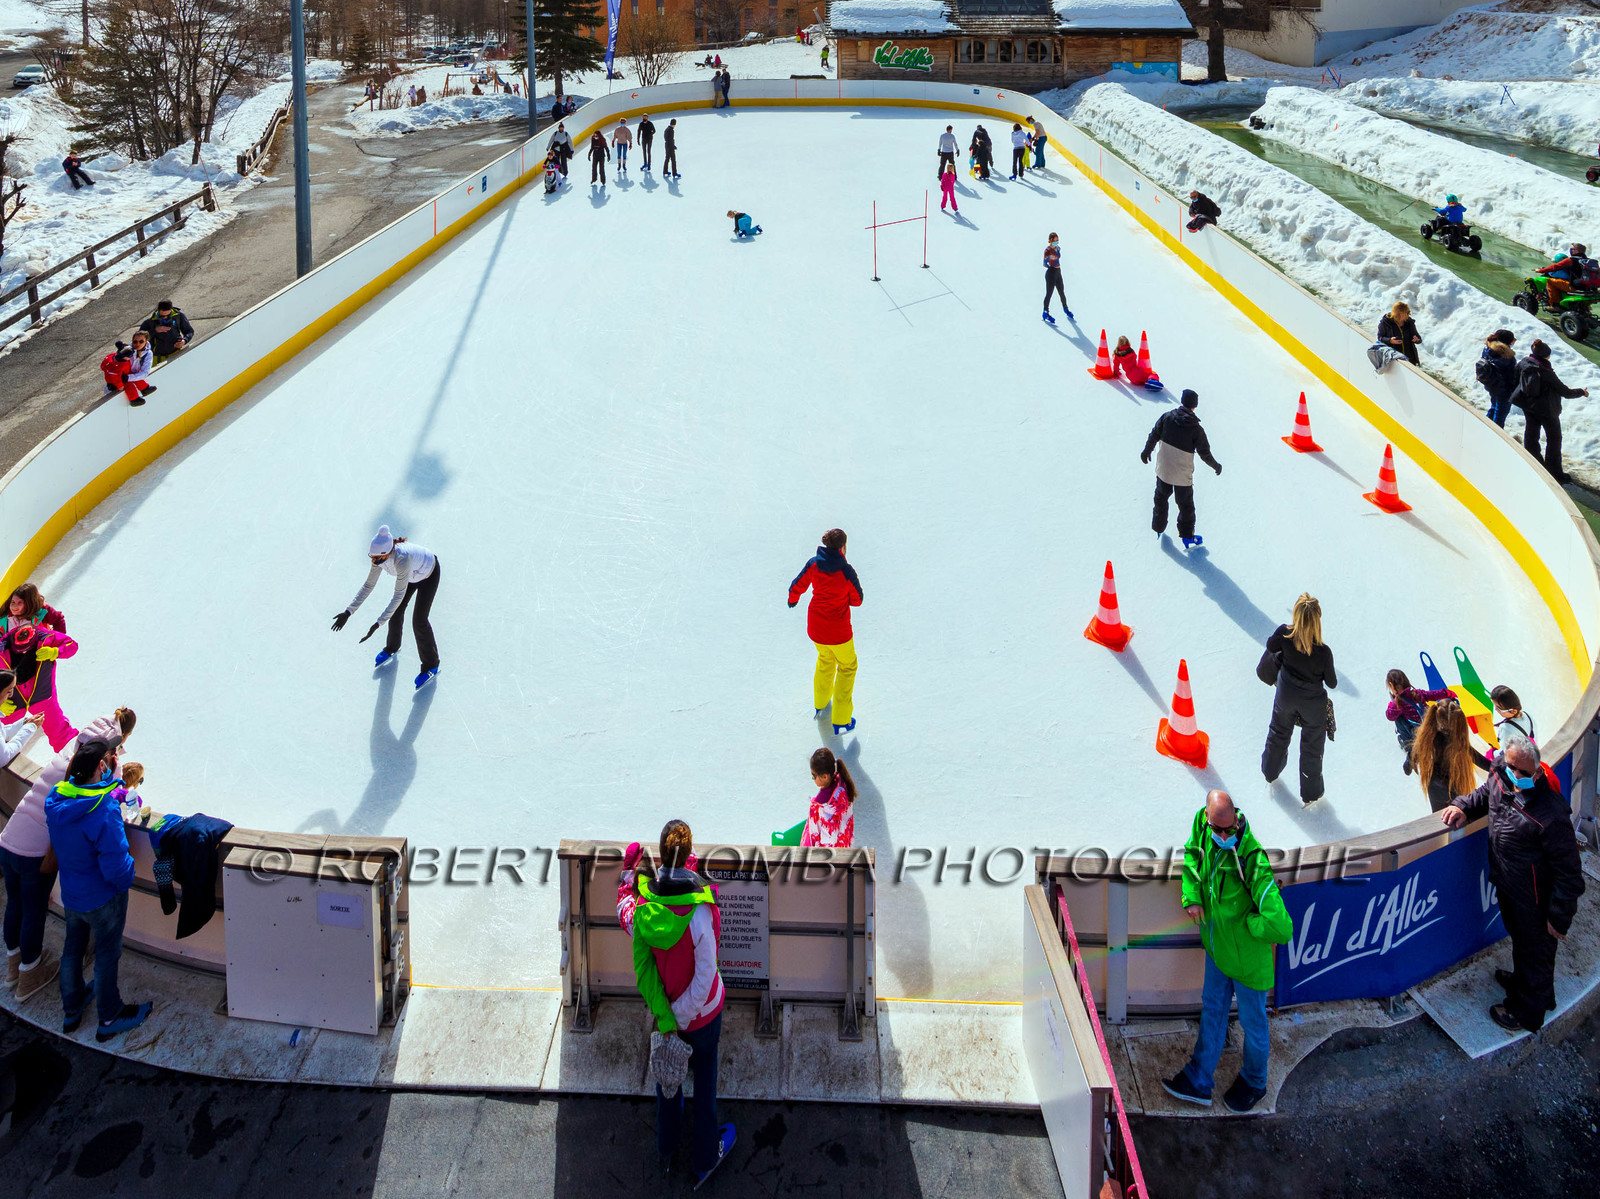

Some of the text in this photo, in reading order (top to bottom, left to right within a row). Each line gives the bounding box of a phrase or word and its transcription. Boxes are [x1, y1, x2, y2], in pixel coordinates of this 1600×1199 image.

[1287, 871, 1439, 970] Val d'Allos
[722, 960, 762, 968] OBLIGATOIRE
